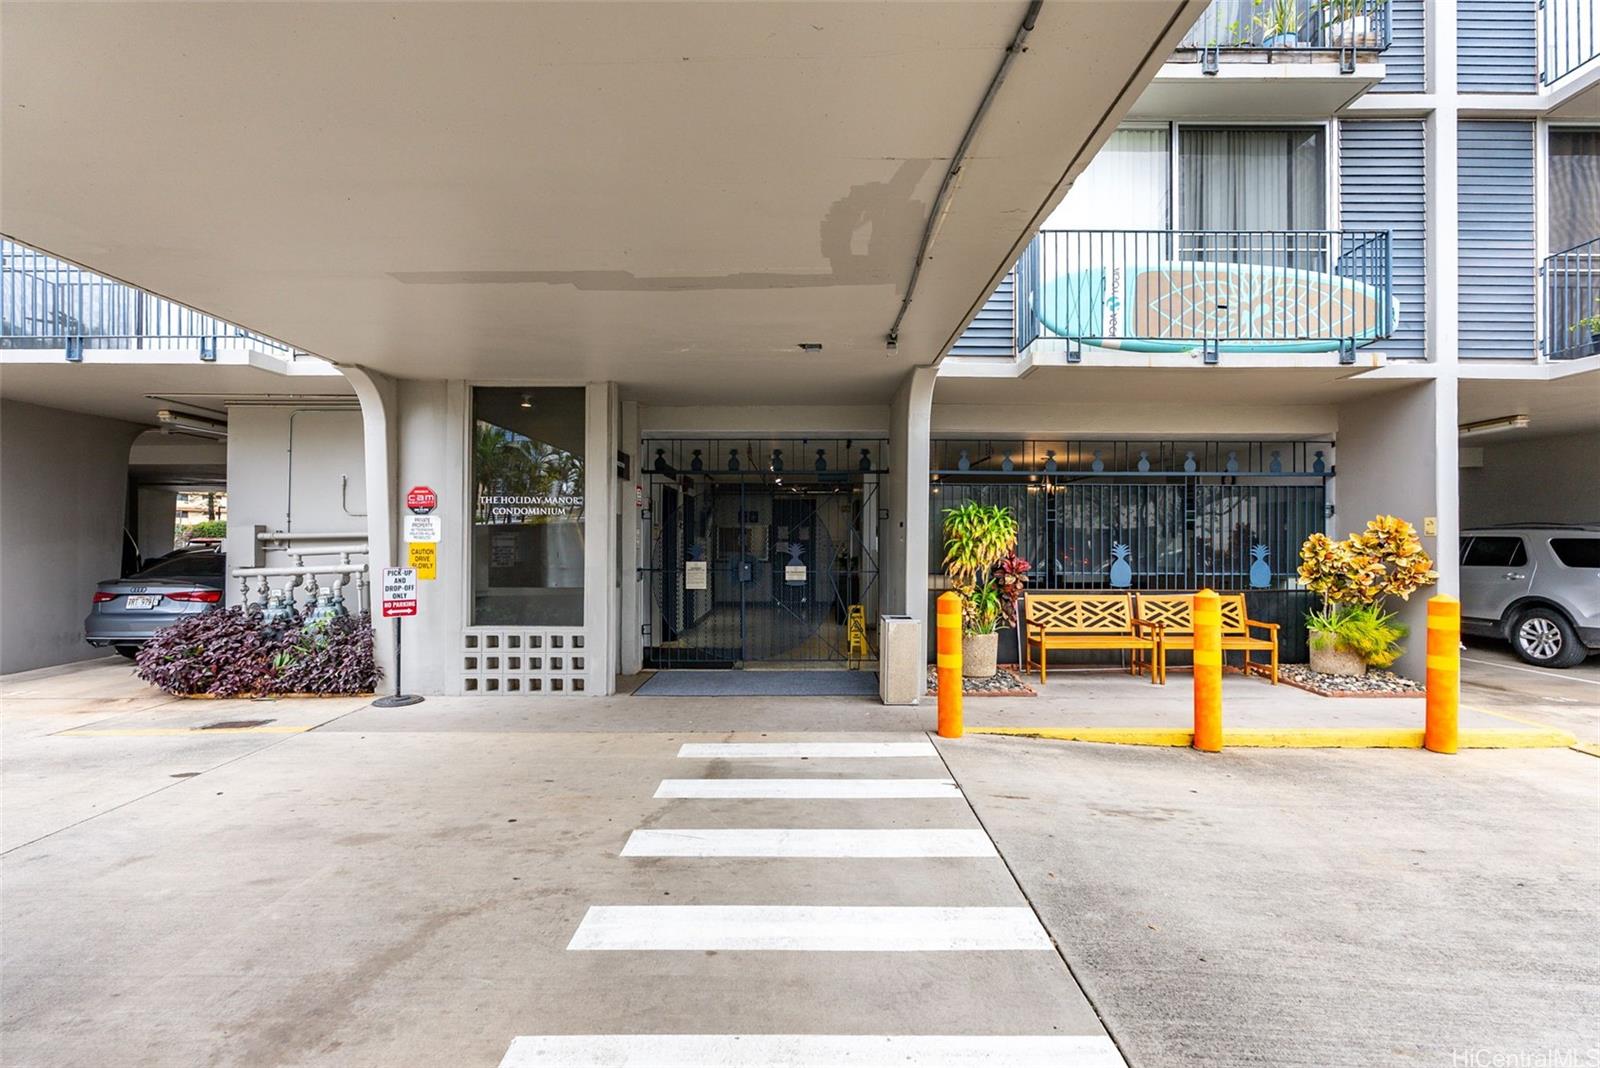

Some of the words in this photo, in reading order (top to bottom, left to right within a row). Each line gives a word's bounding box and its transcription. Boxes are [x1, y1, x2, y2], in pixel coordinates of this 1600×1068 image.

[480, 496, 499, 504] THE
[501, 496, 541, 504] HOLIDAY
[542, 496, 579, 504] MANOR
[492, 507, 566, 515] CONDOMINIUM
